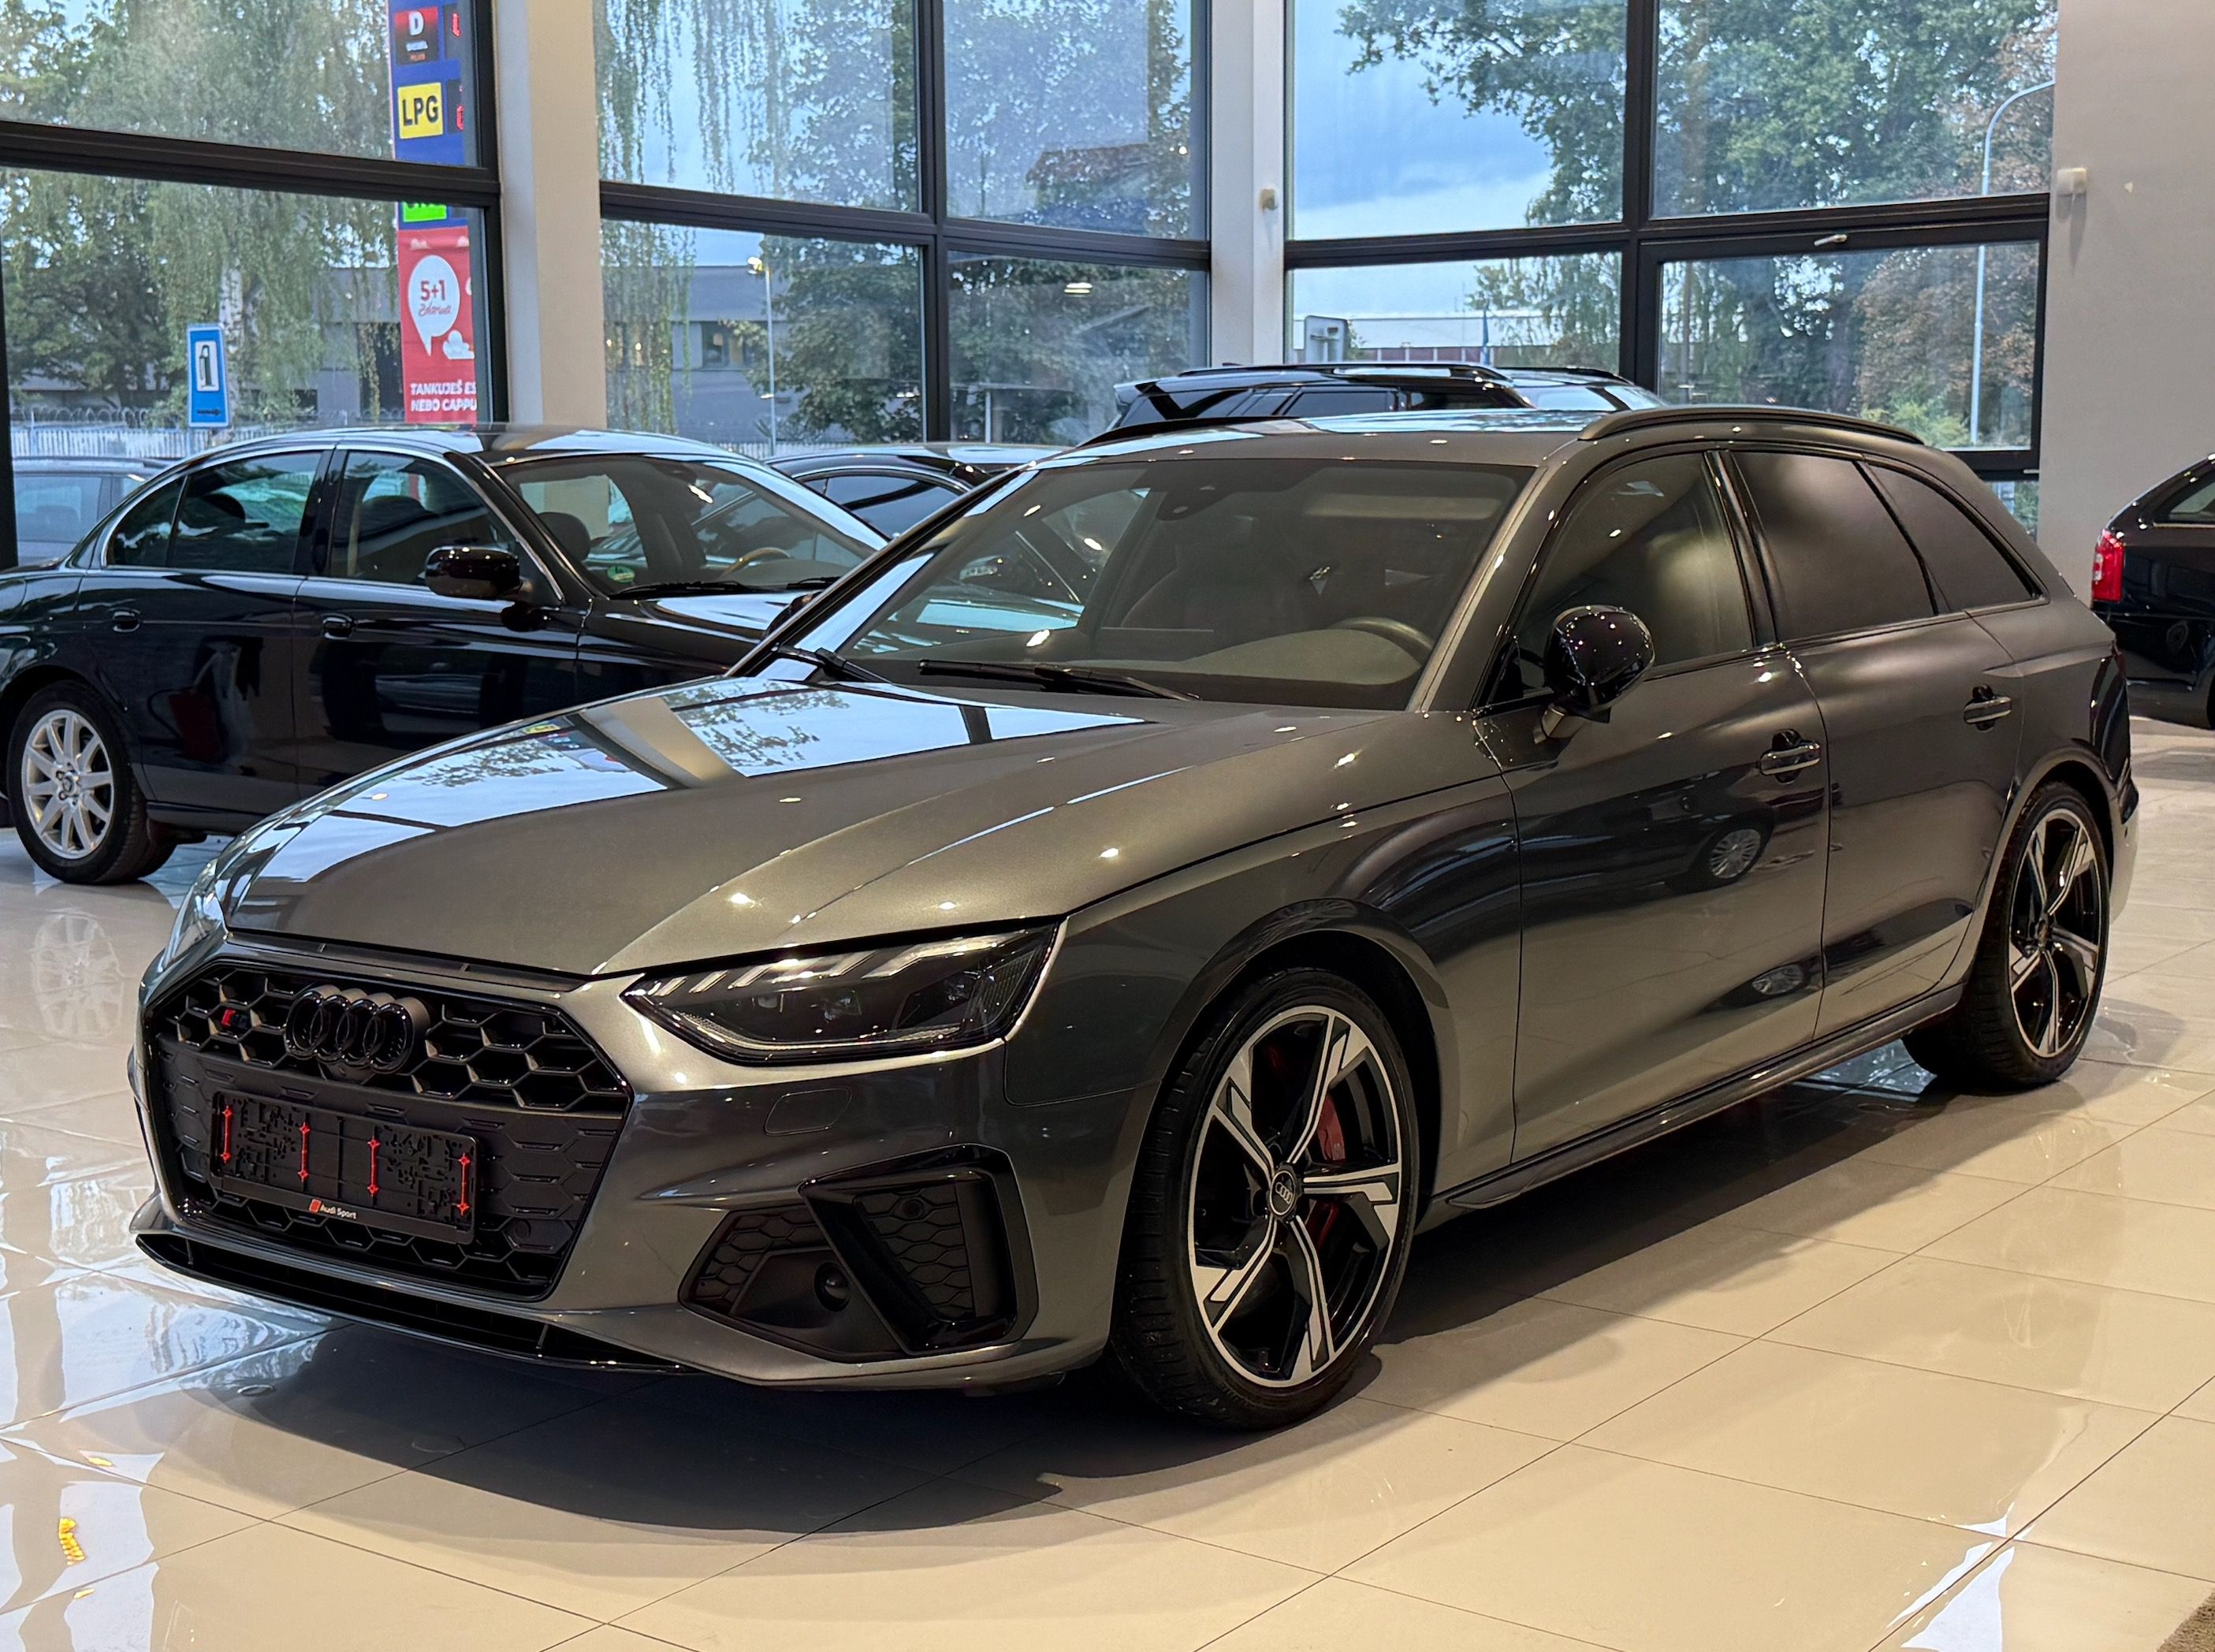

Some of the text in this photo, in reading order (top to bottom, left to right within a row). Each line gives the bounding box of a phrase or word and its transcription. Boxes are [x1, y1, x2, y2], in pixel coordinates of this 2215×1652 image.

[408, 11, 424, 35] D
[402, 95, 438, 126] LPG
[420, 280, 445, 301] 5+1
[410, 379, 463, 395] TANKUJEŠ
[411, 399, 440, 411] NEBO
[320, 1204, 357, 1219] Audi Sport
